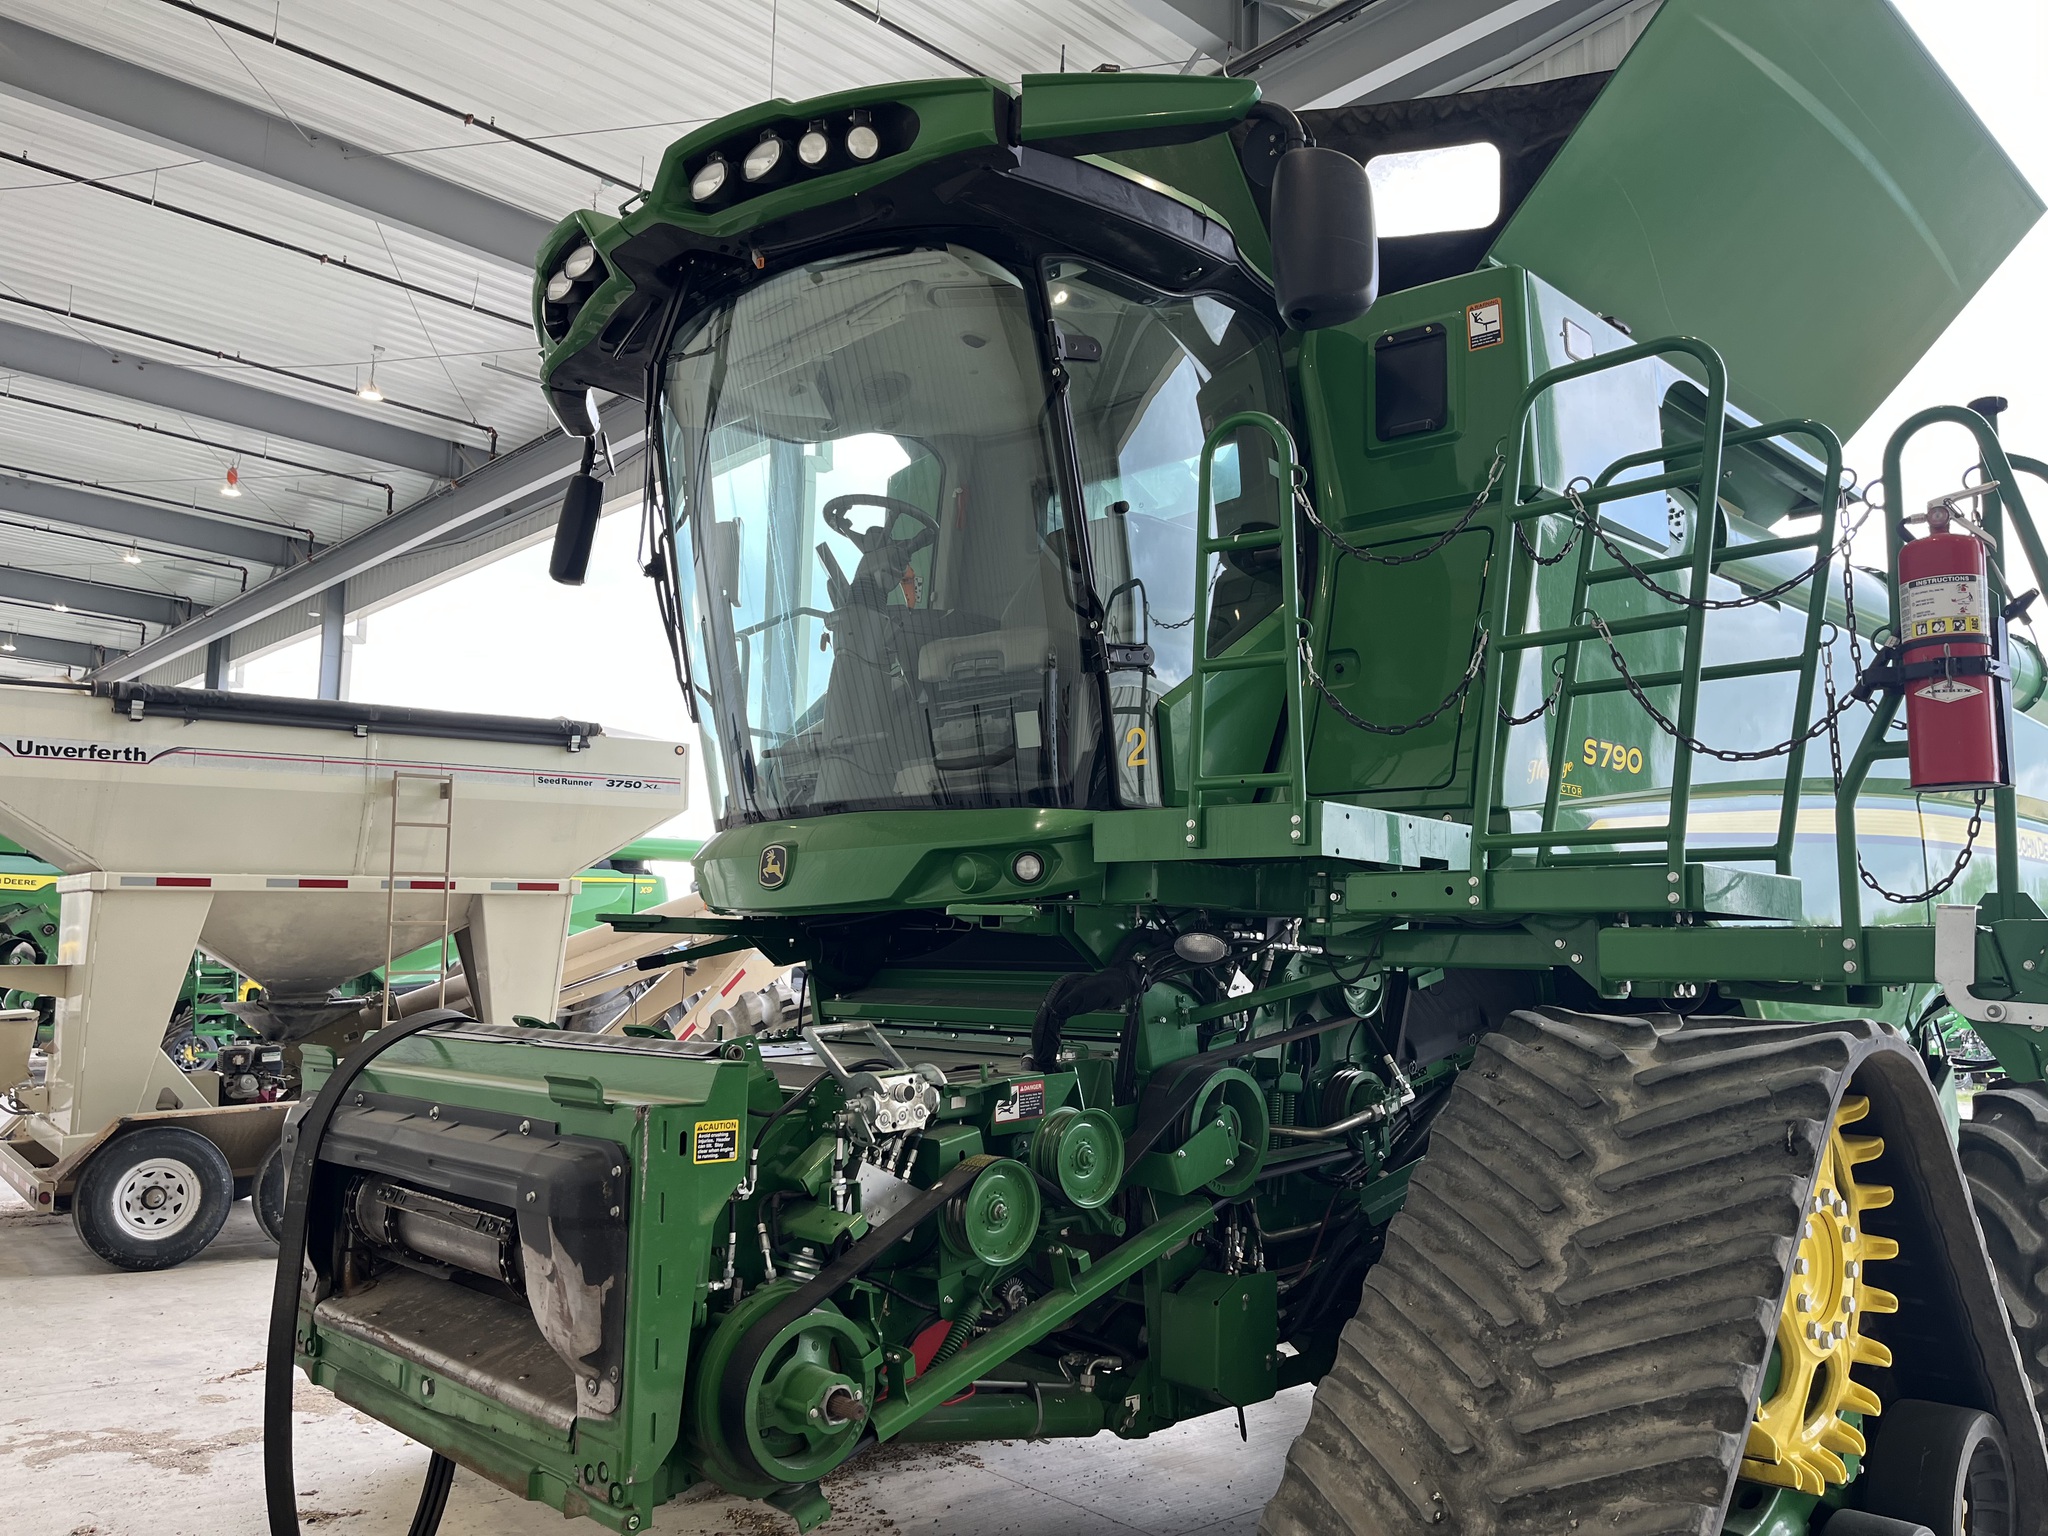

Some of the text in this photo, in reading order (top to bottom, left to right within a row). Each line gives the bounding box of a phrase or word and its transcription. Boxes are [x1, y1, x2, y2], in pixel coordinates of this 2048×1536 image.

[1475, 299, 1499, 309] WARNING
[1916, 575, 1970, 586] INSTRUCTIONS
[16, 740, 147, 762] Unverferth
[1126, 727, 1149, 767] 2
[1583, 738, 1643, 774] S790
[606, 780, 642, 789] 3750
[4, 877, 37, 886] DEERE
[640, 886, 653, 894] X9
[1024, 1083, 1042, 1091] DANGER
[703, 1121, 737, 1131] CAUTION
